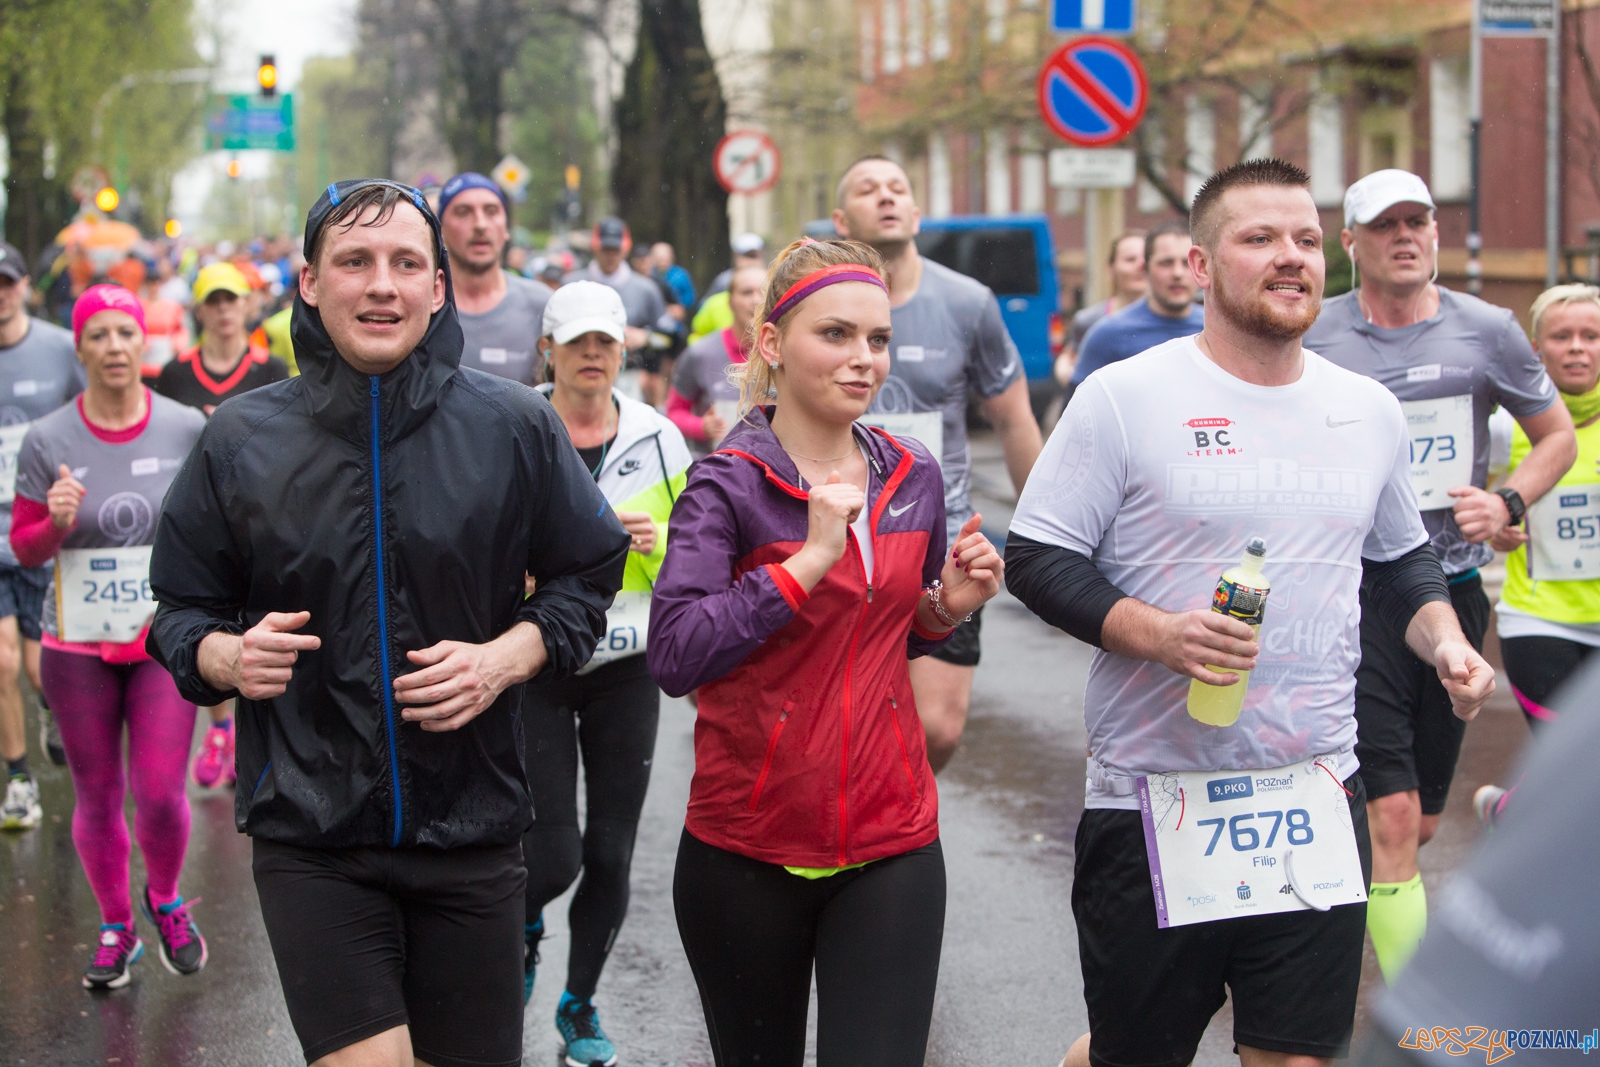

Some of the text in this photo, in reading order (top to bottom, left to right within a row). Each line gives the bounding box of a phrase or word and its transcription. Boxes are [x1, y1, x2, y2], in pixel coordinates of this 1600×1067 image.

[1195, 448, 1236, 457] TEAM
[1191, 493, 1362, 507] WEST COAST
[1196, 808, 1315, 857] 7678
[1253, 854, 1277, 868] Filip
